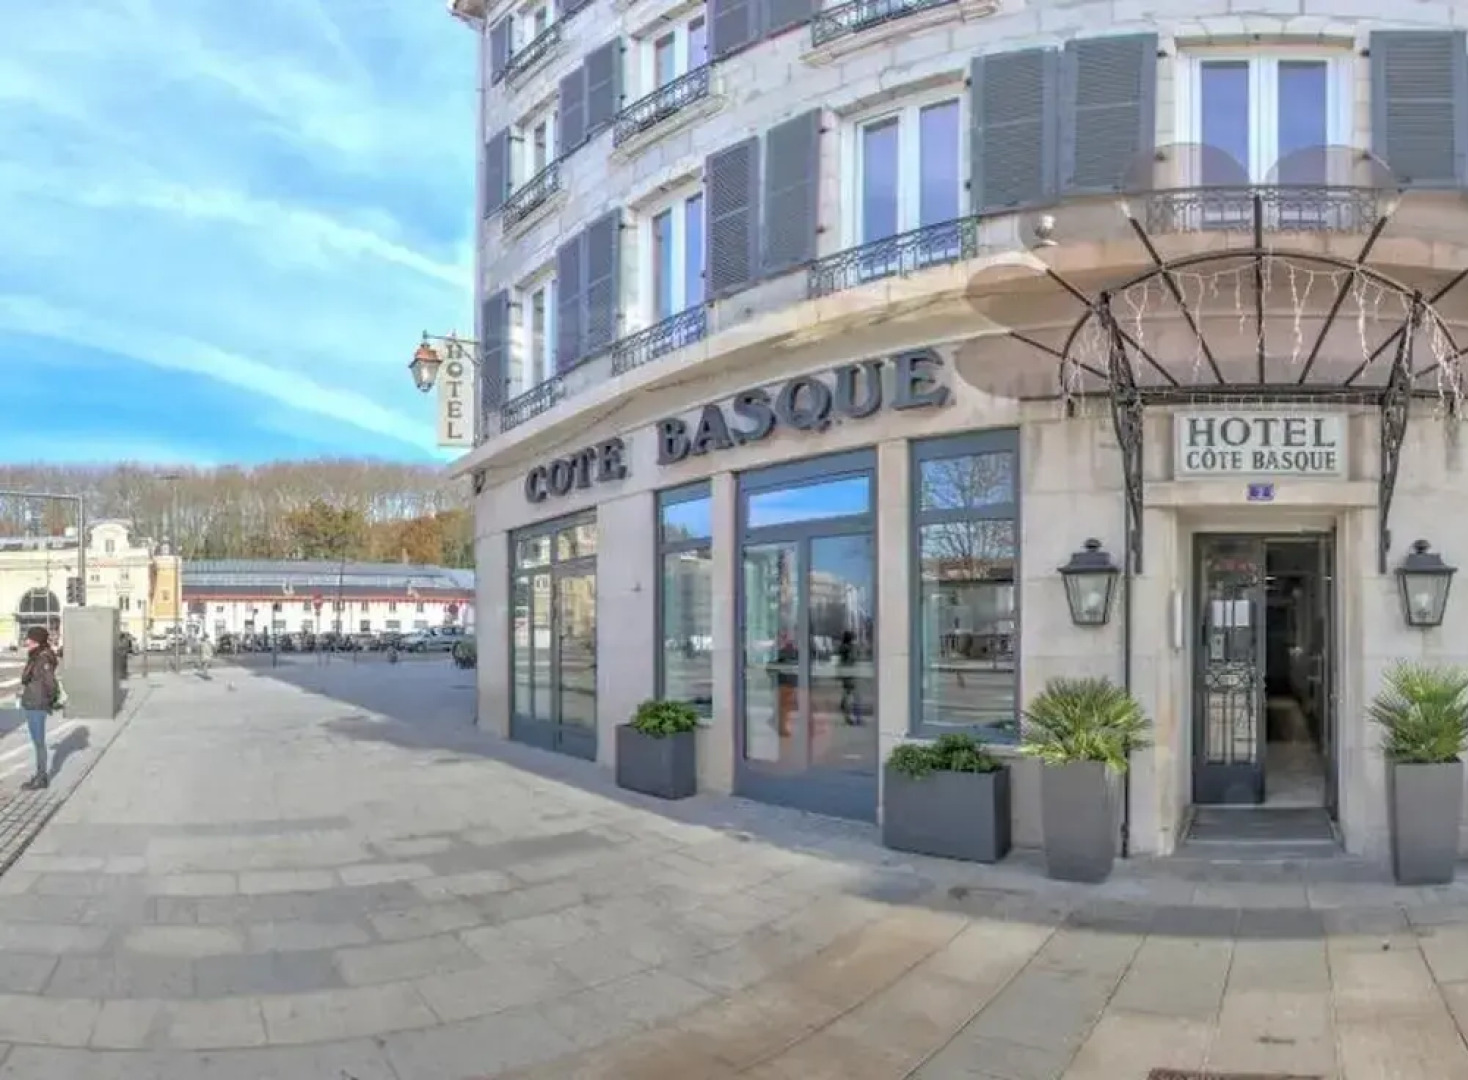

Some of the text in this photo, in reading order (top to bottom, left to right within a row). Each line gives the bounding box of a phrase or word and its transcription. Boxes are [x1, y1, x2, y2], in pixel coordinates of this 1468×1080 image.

[446, 344, 462, 439] HOTEL
[656, 348, 951, 464] BASQUE
[1187, 417, 1336, 447] HOTEL
[1187, 448, 1337, 471] CÔTE BASQUE
